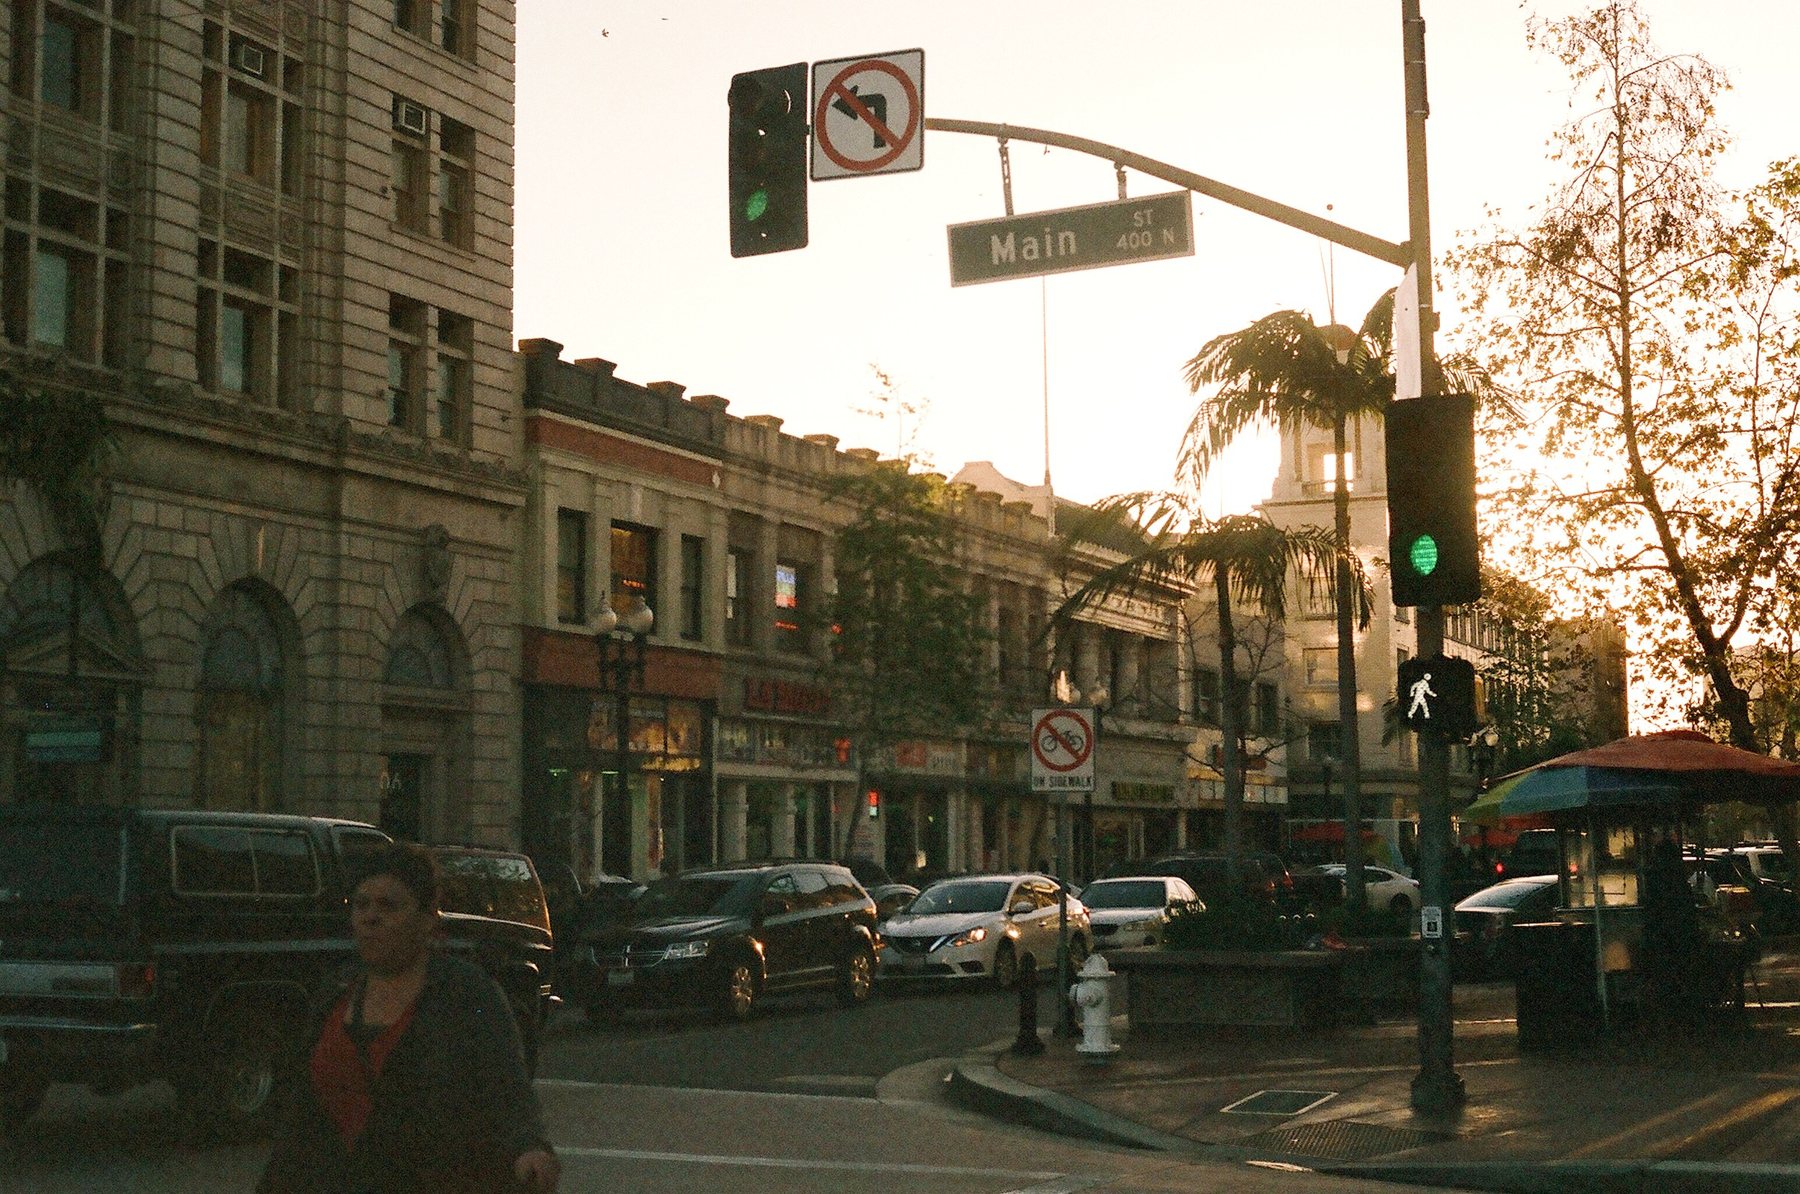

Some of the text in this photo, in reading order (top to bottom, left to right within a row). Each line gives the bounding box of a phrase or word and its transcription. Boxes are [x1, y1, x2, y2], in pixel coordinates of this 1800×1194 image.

[1133, 209, 1154, 228] ST
[990, 227, 1077, 266] Main
[1116, 227, 1175, 251] 400 N
[1034, 775, 1092, 788] ON SIDEWALK
